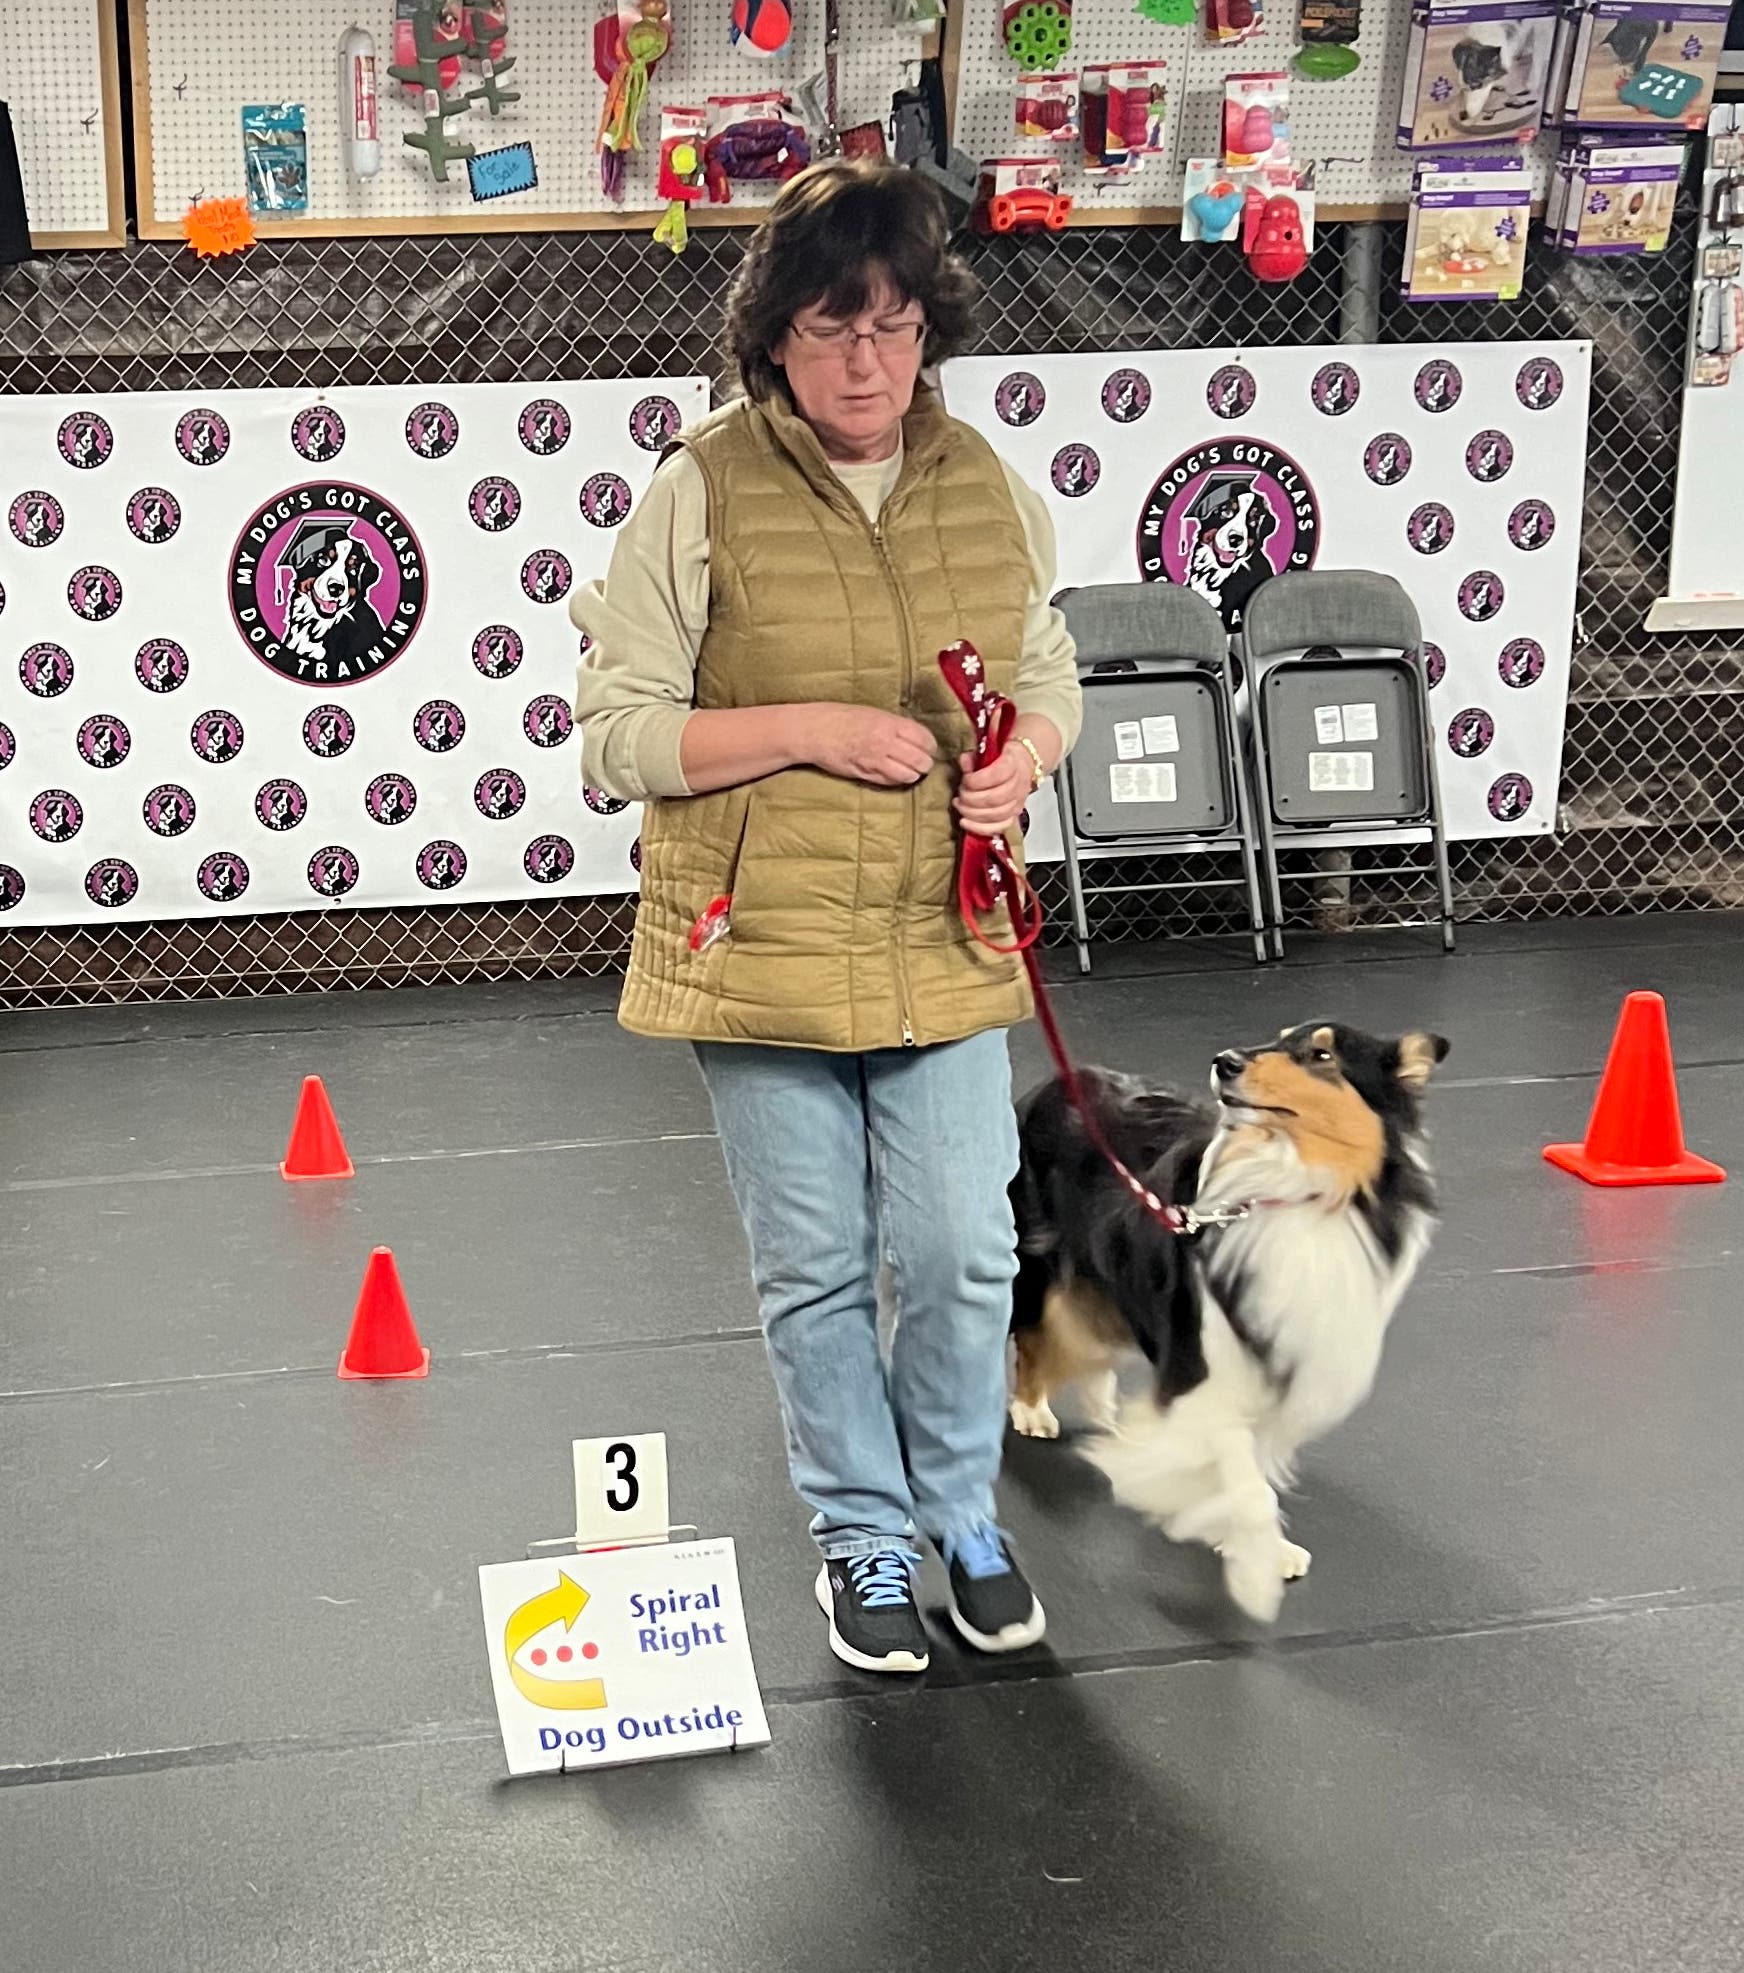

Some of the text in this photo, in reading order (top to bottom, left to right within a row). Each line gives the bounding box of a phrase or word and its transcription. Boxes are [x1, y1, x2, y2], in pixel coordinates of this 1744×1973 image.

[478, 161, 496, 179] For
[1144, 444, 1314, 536] MY DOG'S GOT CLASS
[237, 488, 420, 585] MY DOG'S GOT CLASS
[240, 607, 281, 659] DOG
[297, 601, 416, 679] TRAINING
[605, 1442, 640, 1512] 3
[630, 1584, 721, 1624] Spiral
[638, 1621, 728, 1657] Right
[538, 1705, 744, 1753] Dog Outside
